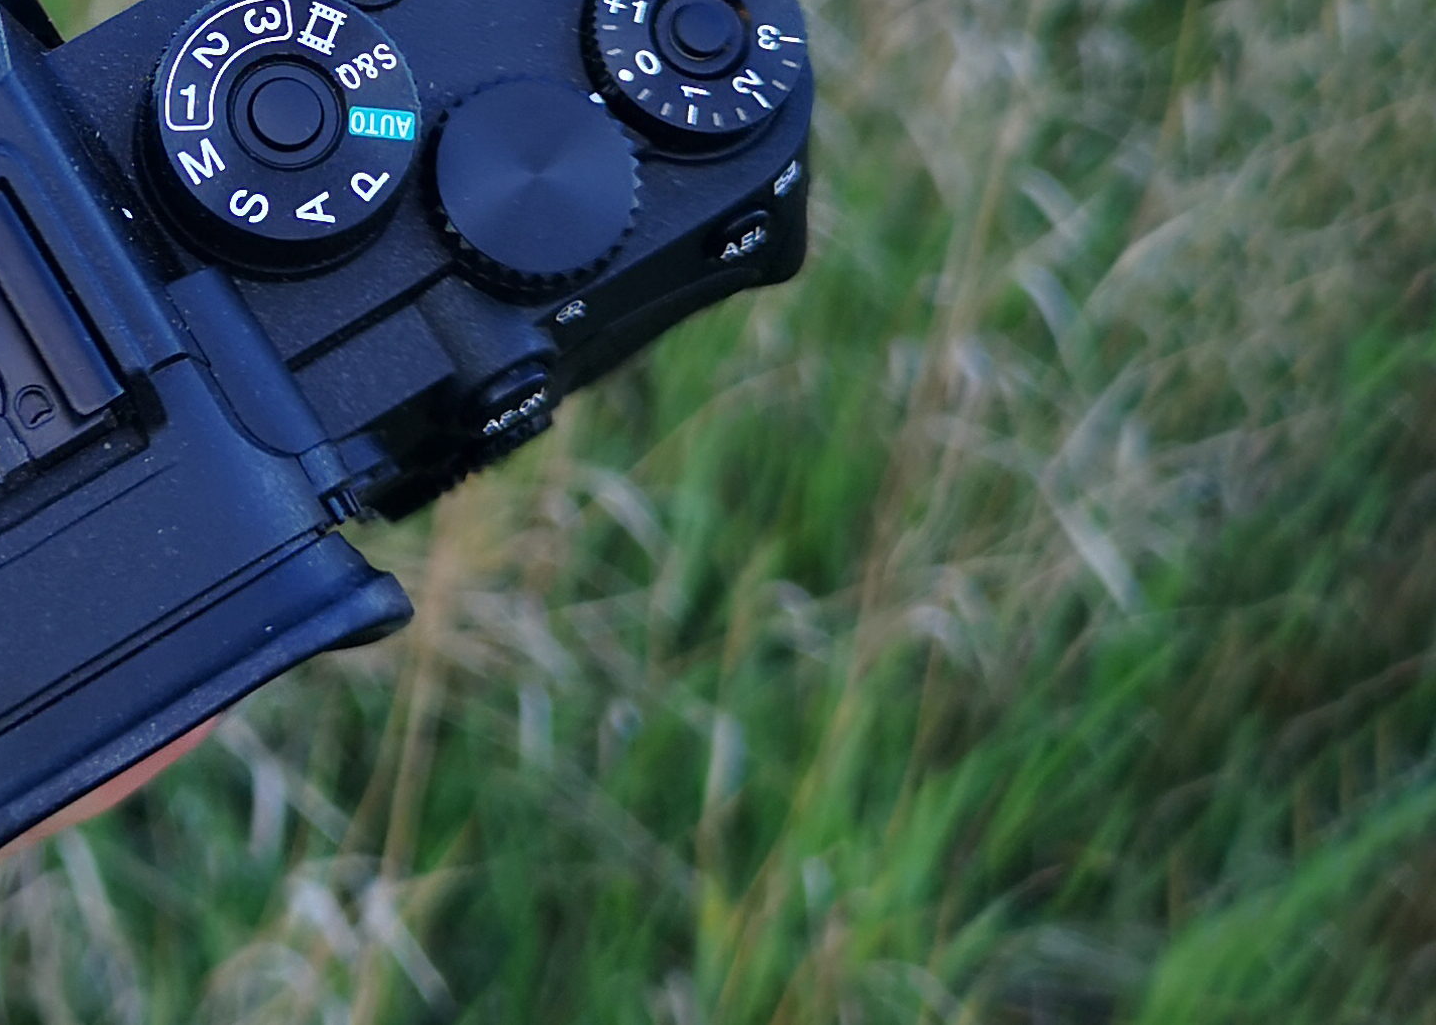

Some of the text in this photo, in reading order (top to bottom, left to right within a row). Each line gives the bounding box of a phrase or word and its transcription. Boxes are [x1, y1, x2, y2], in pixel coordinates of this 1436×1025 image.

[243, 6, 282, 35] 3
[191, 31, 230, 69] 2
[635, 50, 662, 75] 0
[180, 84, 196, 120] 1
[350, 110, 412, 139] AUTO
[177, 138, 226, 186] M
[350, 172, 390, 202] P
[229, 189, 269, 224] S
[295, 191, 336, 224] A
